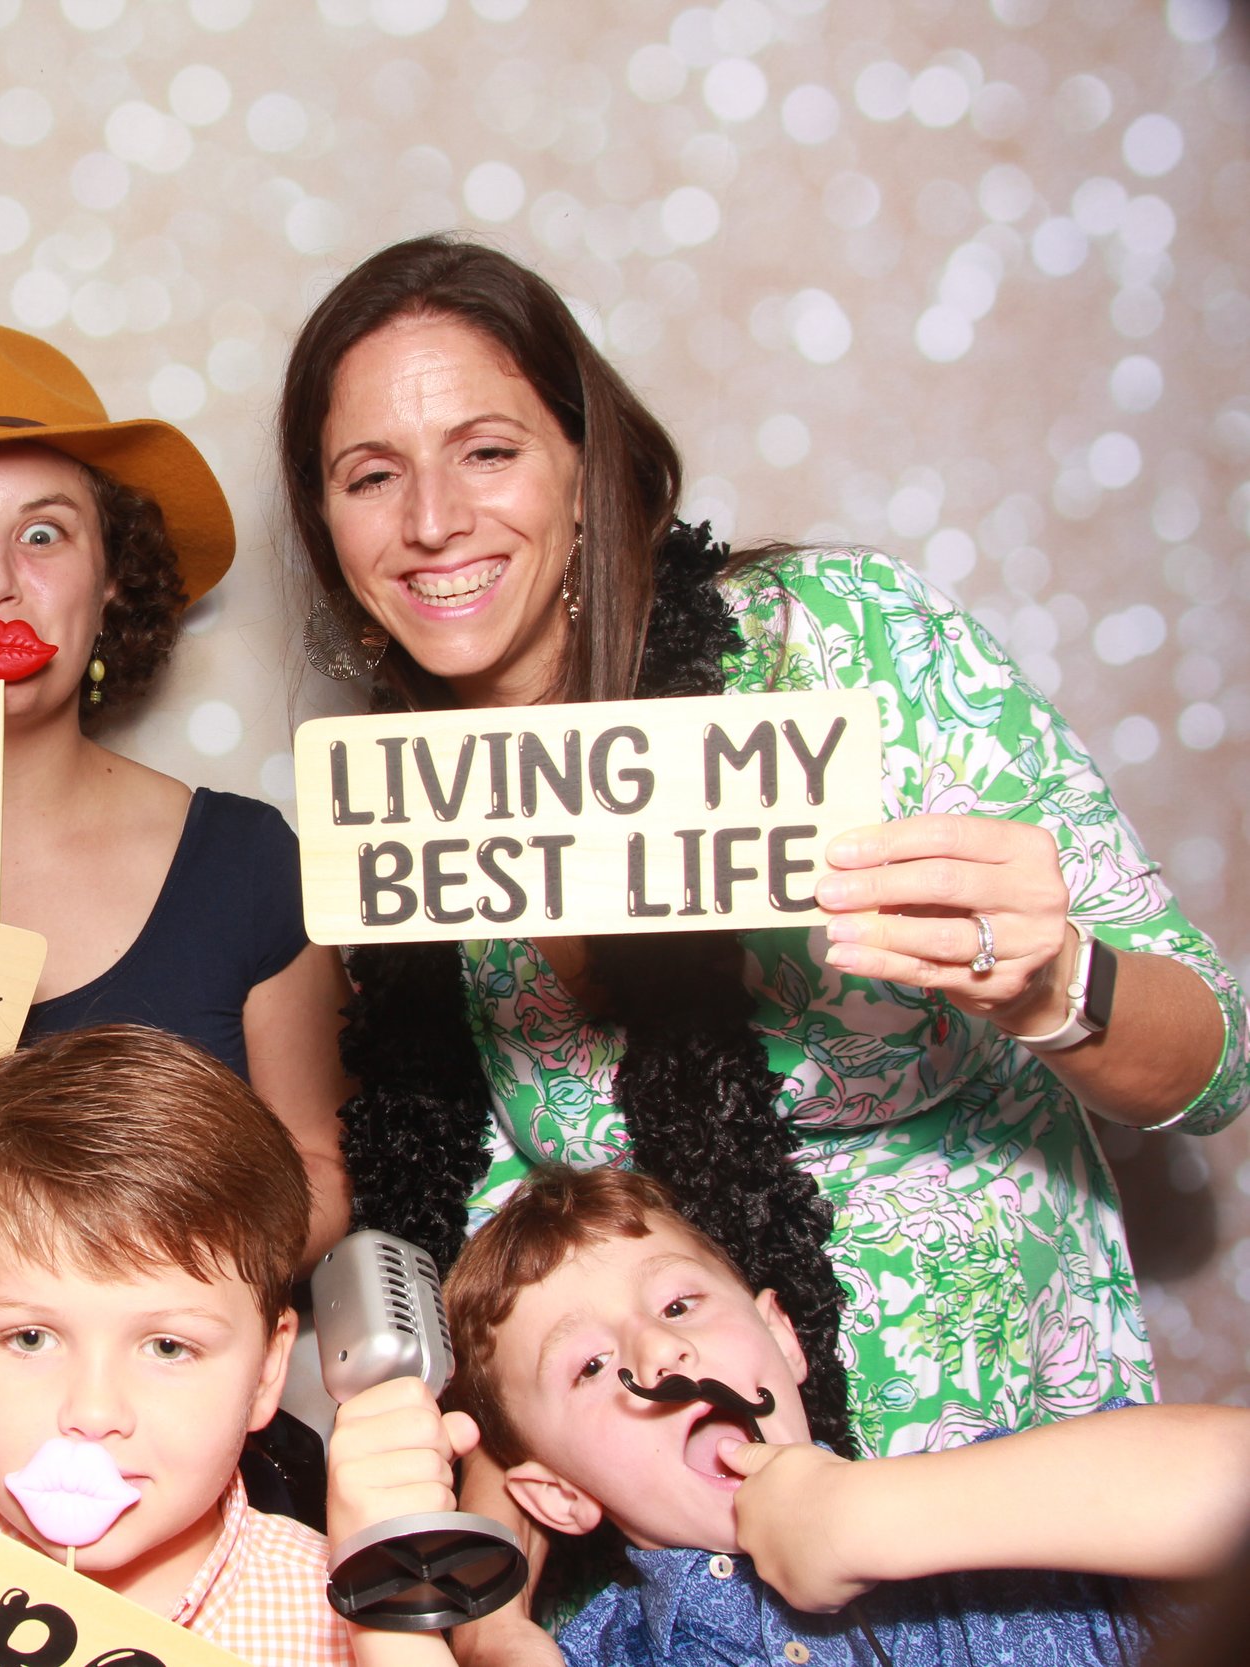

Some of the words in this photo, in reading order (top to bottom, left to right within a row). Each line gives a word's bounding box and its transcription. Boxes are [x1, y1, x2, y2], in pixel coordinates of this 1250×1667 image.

[329, 725, 655, 826] LIVING
[703, 716, 847, 811] MY
[358, 834, 576, 927] BEST
[627, 824, 821, 917] LIFE
